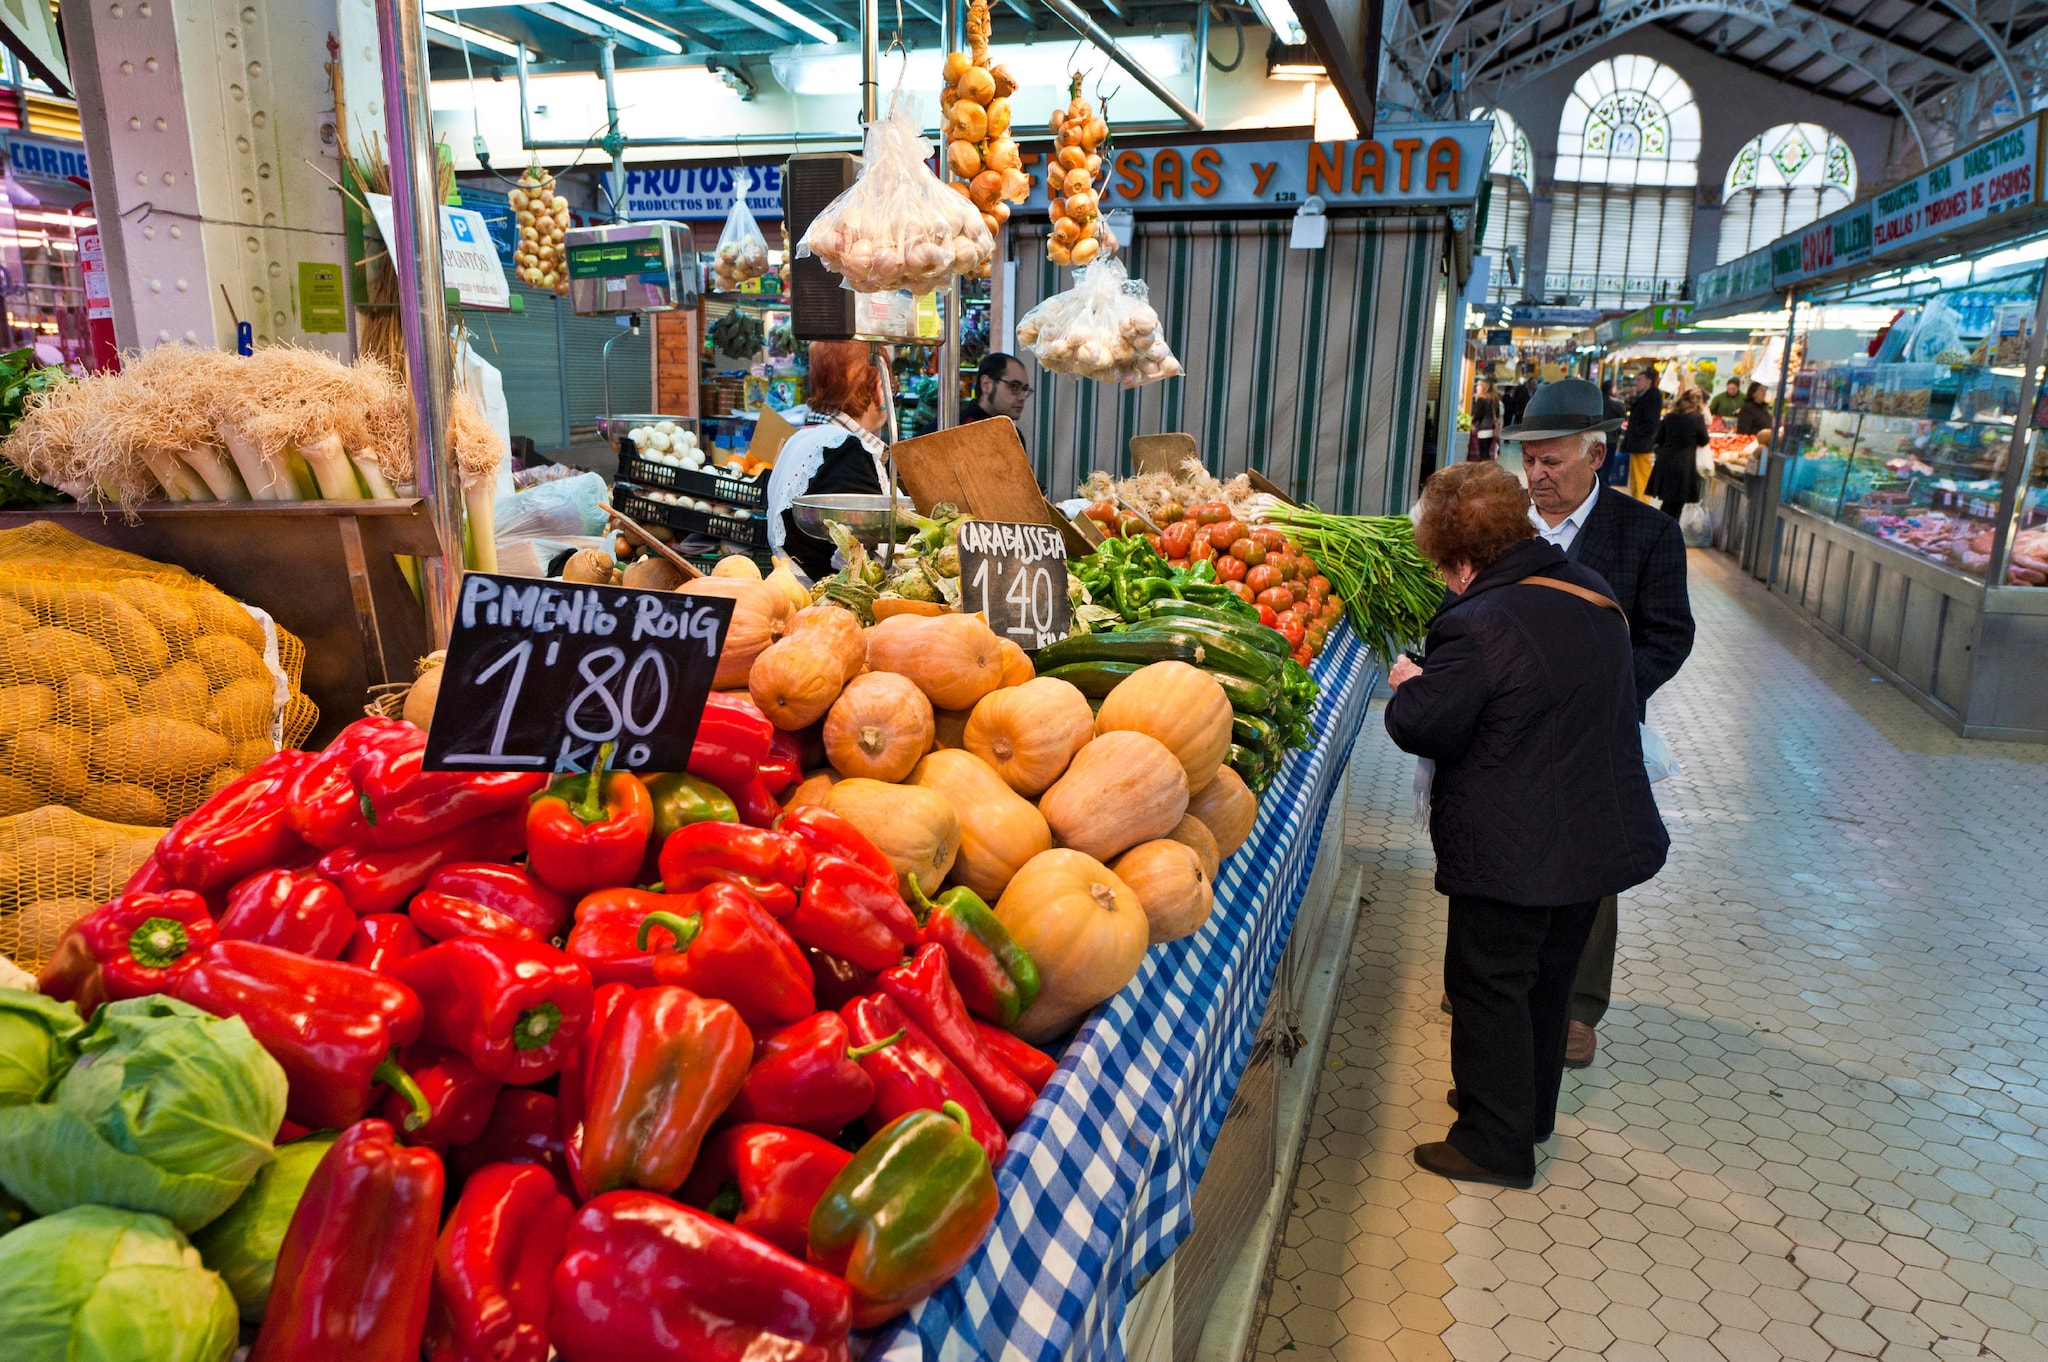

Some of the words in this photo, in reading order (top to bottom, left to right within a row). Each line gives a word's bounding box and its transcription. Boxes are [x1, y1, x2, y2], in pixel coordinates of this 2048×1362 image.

[10, 142, 89, 179] CARNE
[1019, 147, 1221, 201] FSAS
[1307, 136, 1462, 194] NATA
[626, 166, 735, 197] FRUTOS
[747, 165, 781, 193] SE
[1274, 192, 1297, 201] 138
[1928, 166, 1952, 196] PARA
[1971, 182, 1985, 211] DE
[1988, 164, 2031, 204] CASINOS
[629, 198, 701, 212] PRODUCTOS
[707, 198, 723, 210] DE
[727, 197, 783, 210] AERICA
[453, 218, 468, 237] P
[1802, 225, 1834, 273] CRUZ
[960, 522, 1067, 565] CARABASSETA
